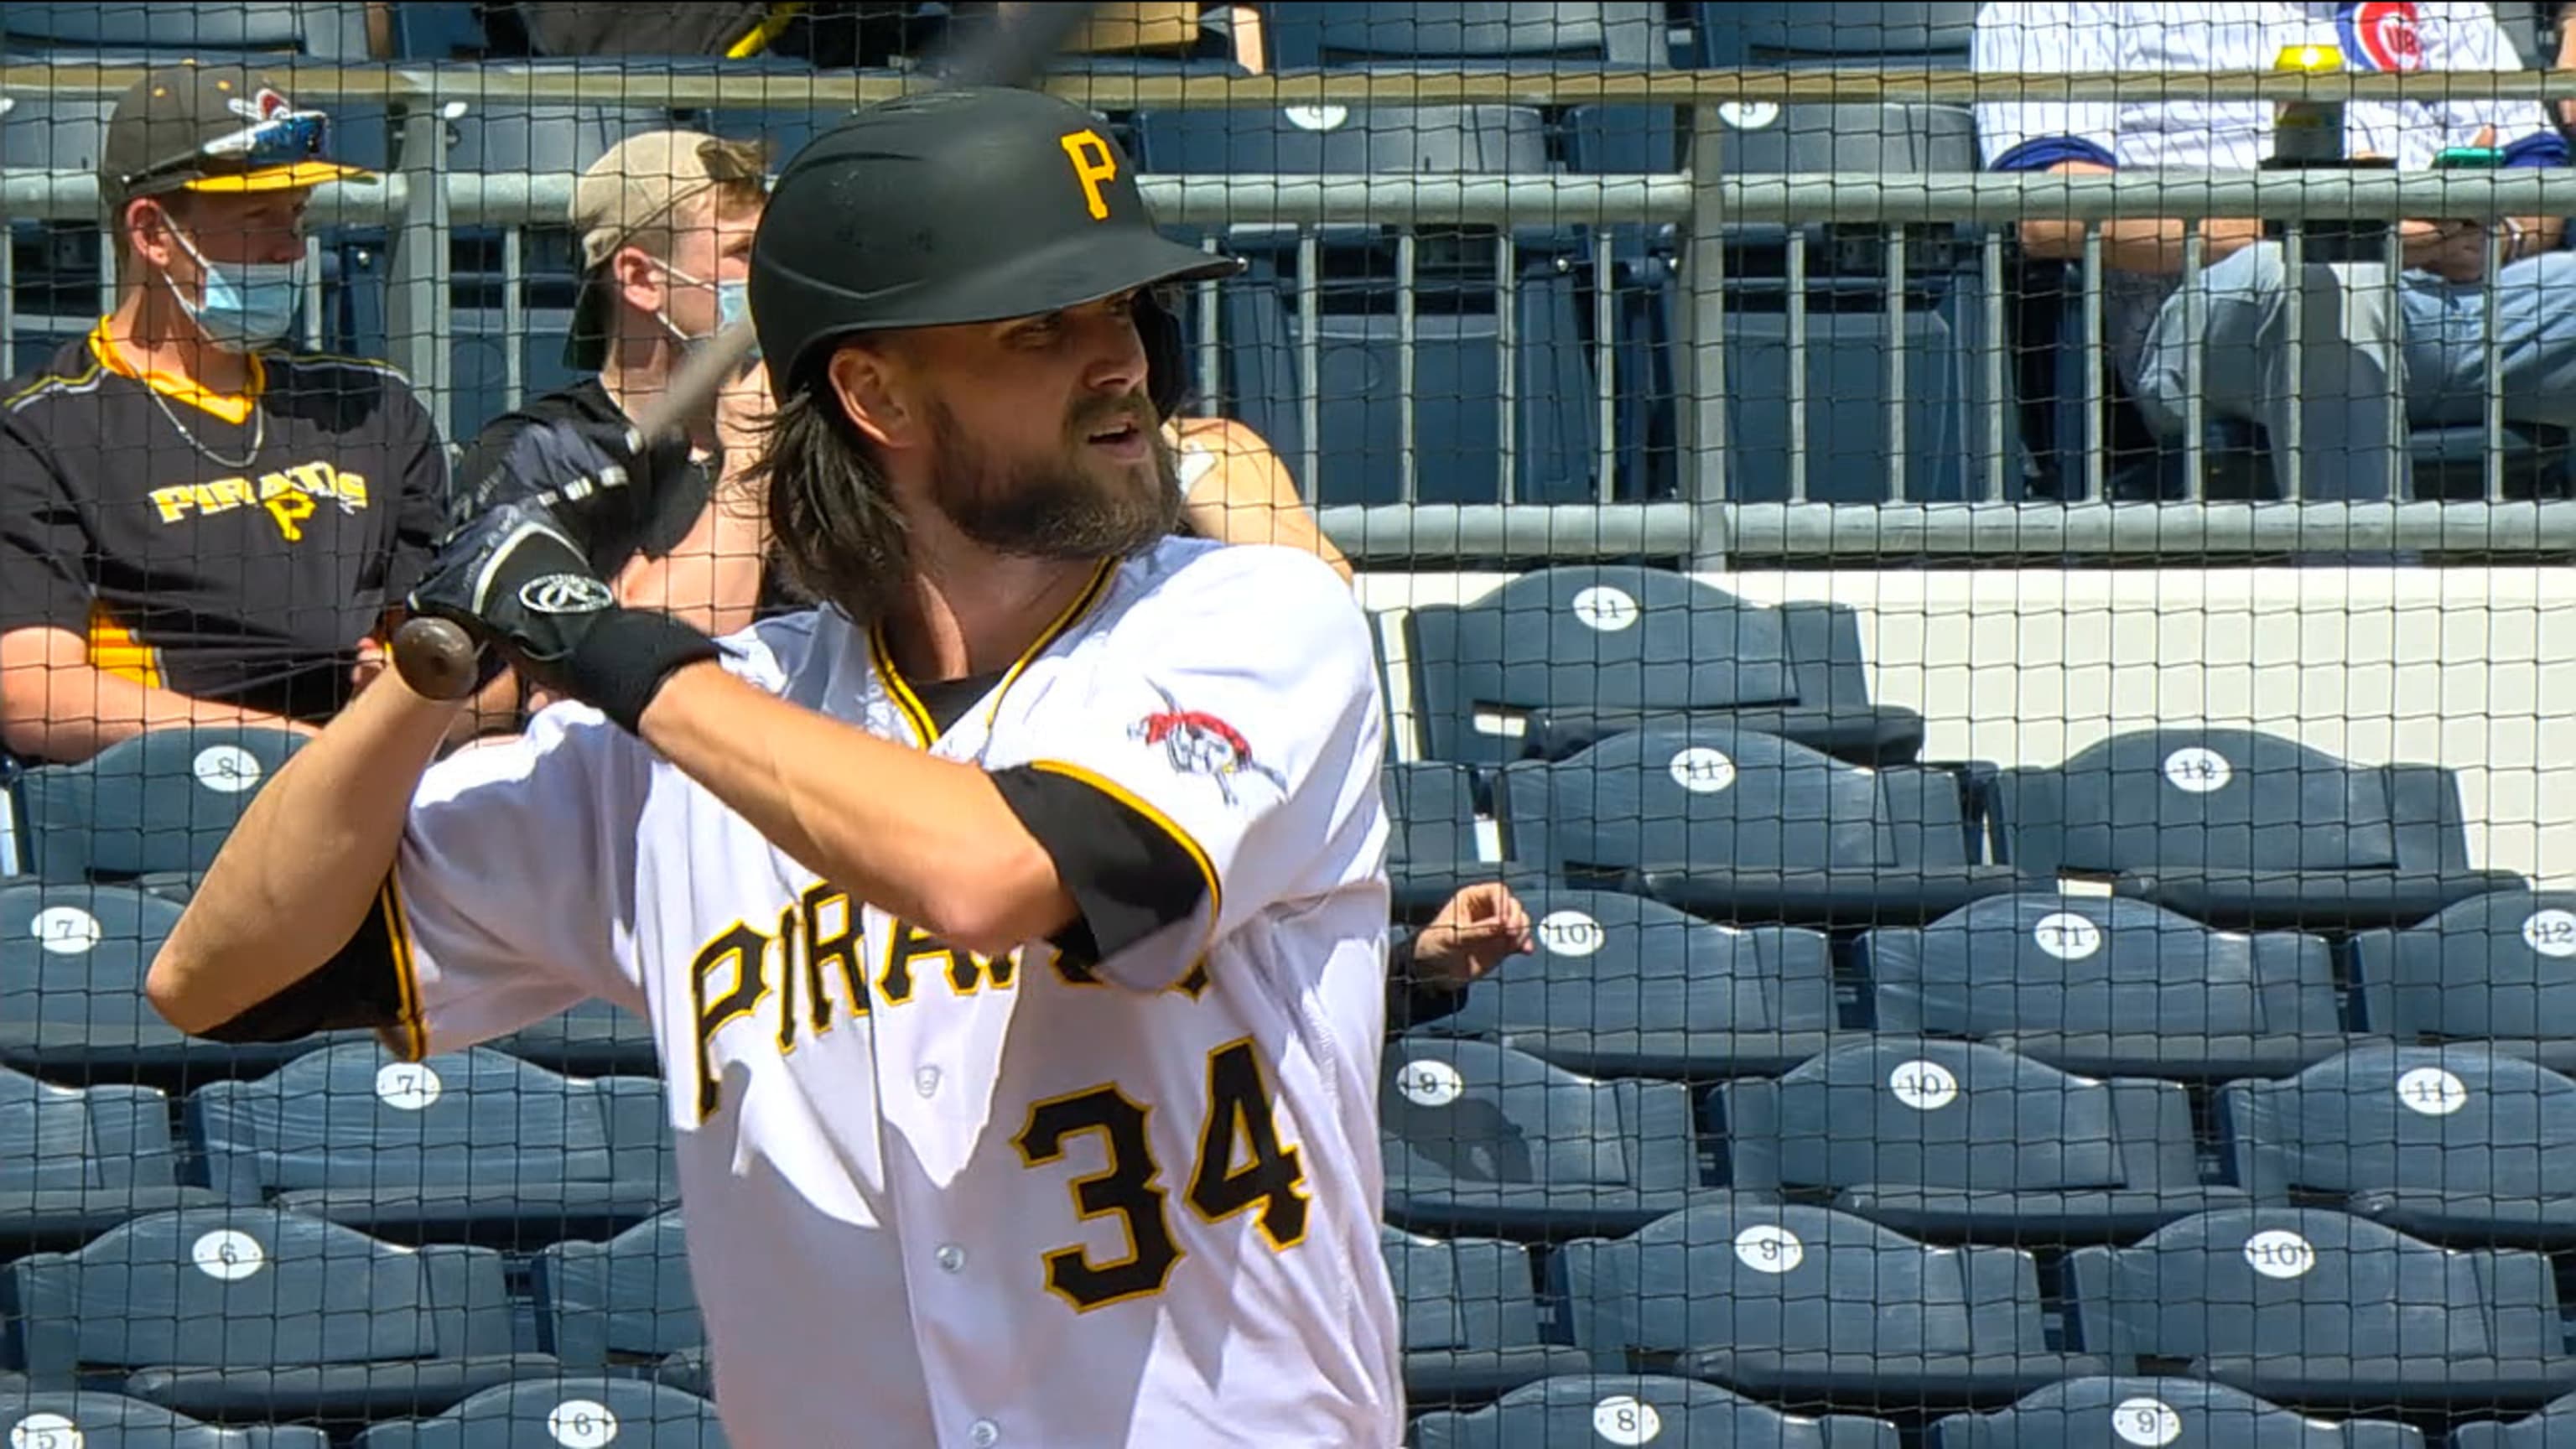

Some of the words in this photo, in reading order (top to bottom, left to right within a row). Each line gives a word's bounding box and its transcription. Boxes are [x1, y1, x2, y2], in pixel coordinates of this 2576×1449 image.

[1060, 128, 1117, 220] P
[264, 490, 316, 541] P
[1592, 599, 1620, 619] 11
[217, 757, 236, 780] 8
[1688, 759, 1719, 780] 11
[2180, 759, 2217, 780] 12
[55, 920, 75, 939] 7
[1555, 924, 1588, 944] 10
[2053, 927, 2085, 947] 11
[2540, 922, 2573, 945] 12
[396, 1074, 416, 1094] 7
[1419, 1072, 1439, 1094] 9
[1908, 1073, 1941, 1096] 10
[2415, 1081, 2447, 1103] 11
[1010, 1035, 1311, 1314] 34
[218, 1242, 237, 1265] 6
[1759, 1238, 1780, 1260] 9
[2262, 1243, 2297, 1265] 10
[574, 1412, 593, 1436] 6
[1616, 1409, 1636, 1432] 8
[2135, 1410, 2156, 1434] 9
[37, 1430, 57, 1449] 5
